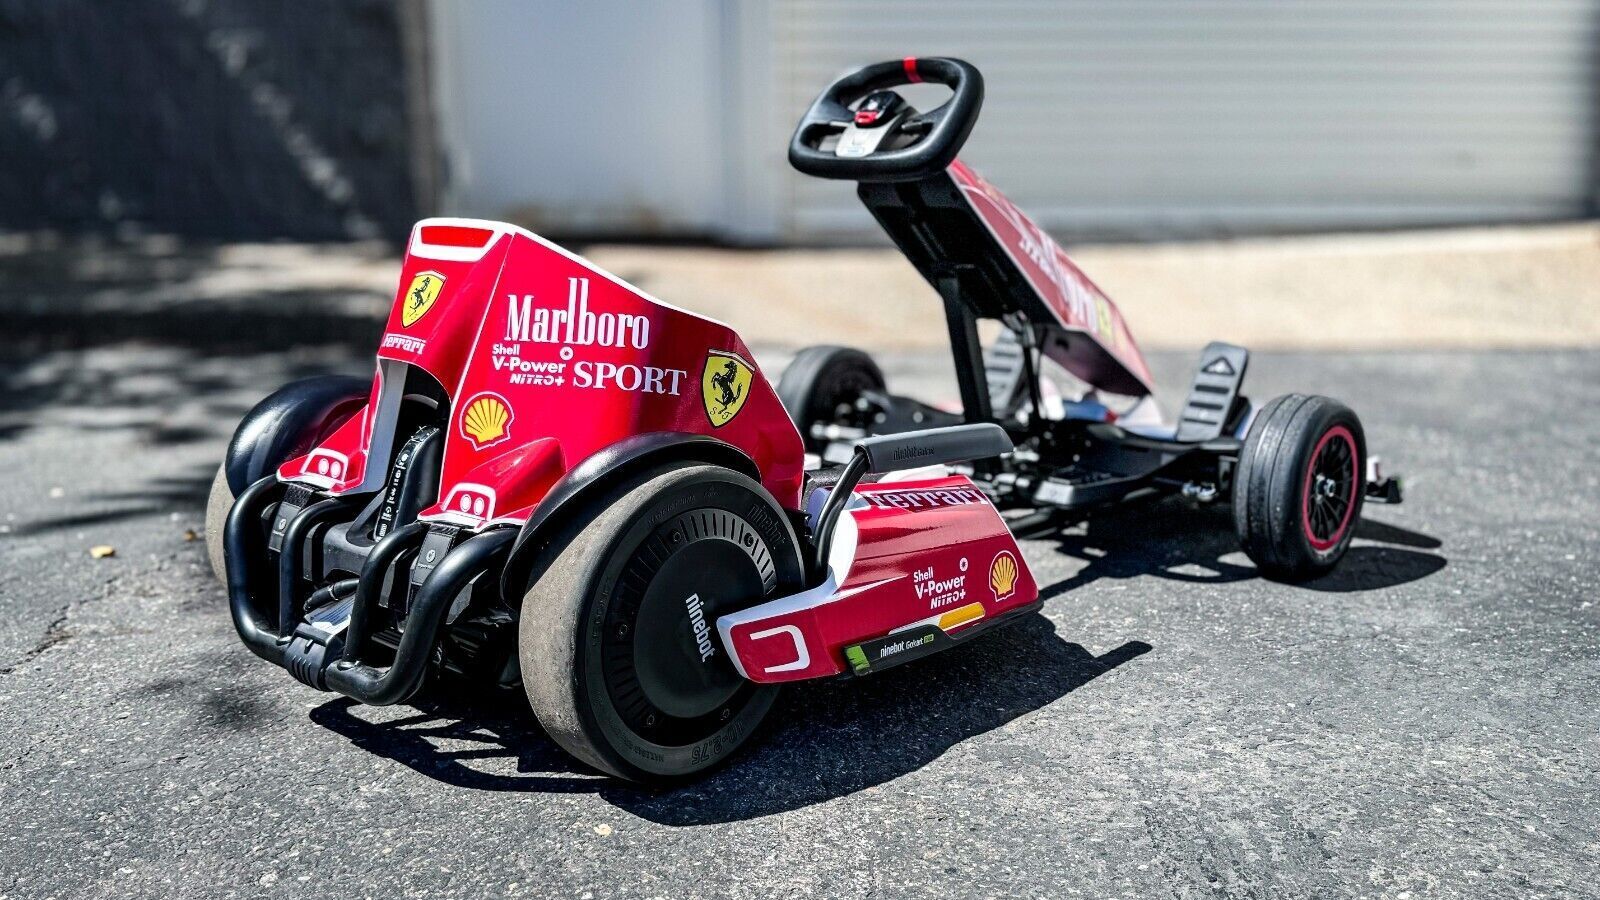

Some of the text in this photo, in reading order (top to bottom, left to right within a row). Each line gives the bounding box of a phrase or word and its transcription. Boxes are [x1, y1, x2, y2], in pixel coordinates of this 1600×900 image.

[504, 277, 650, 349] Marlboro
[492, 343, 520, 355] Shell
[492, 355, 566, 373] V-Power
[573, 361, 687, 396] SPORT
[867, 485, 989, 509] Ferrari
[914, 566, 934, 583] Shell
[914, 575, 966, 600] V-Power
[685, 593, 715, 663] ninebot
[880, 641, 905, 658] ninebot
